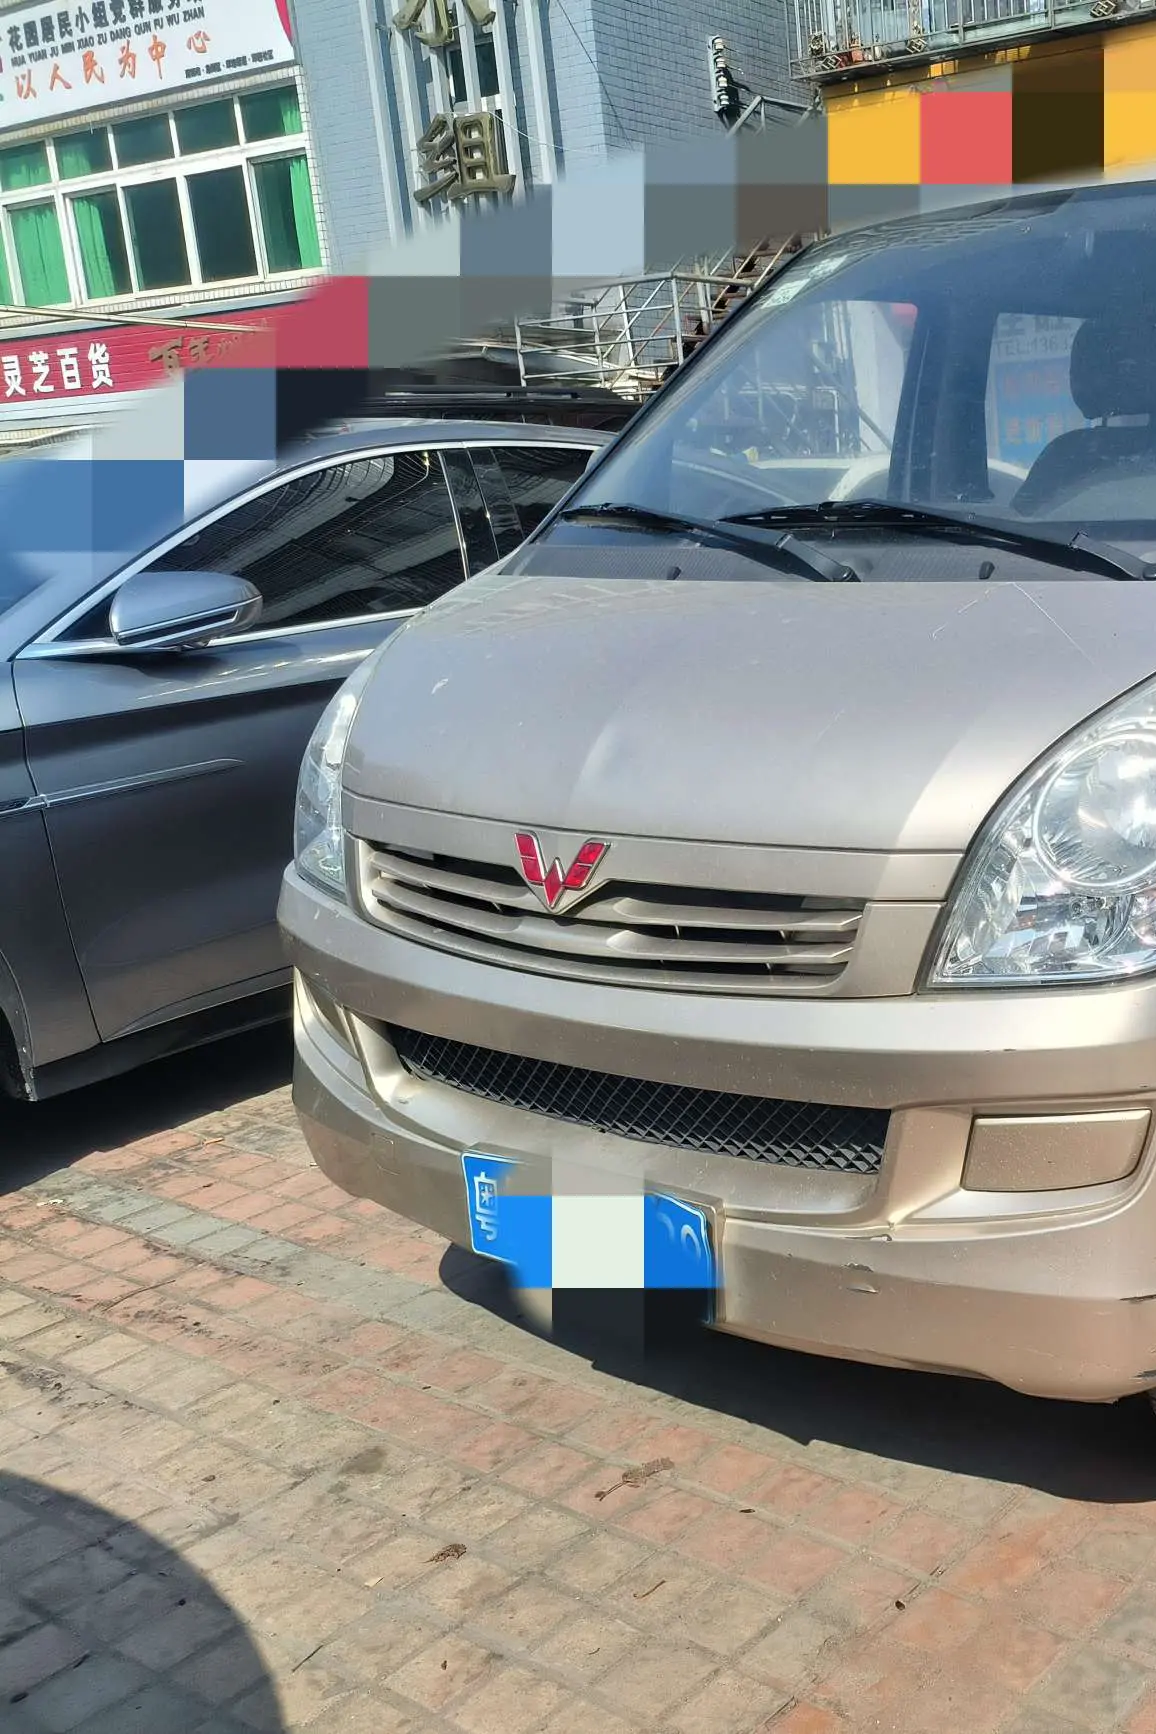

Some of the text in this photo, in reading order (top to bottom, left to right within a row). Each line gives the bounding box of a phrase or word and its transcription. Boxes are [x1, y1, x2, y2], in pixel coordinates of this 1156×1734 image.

[7, 0, 200, 53] 花园居民小组党群服
[110, 26, 131, 42] DANG
[15, 30, 211, 99] 以人民为中心
[1, 342, 113, 398] 灵芝百货
